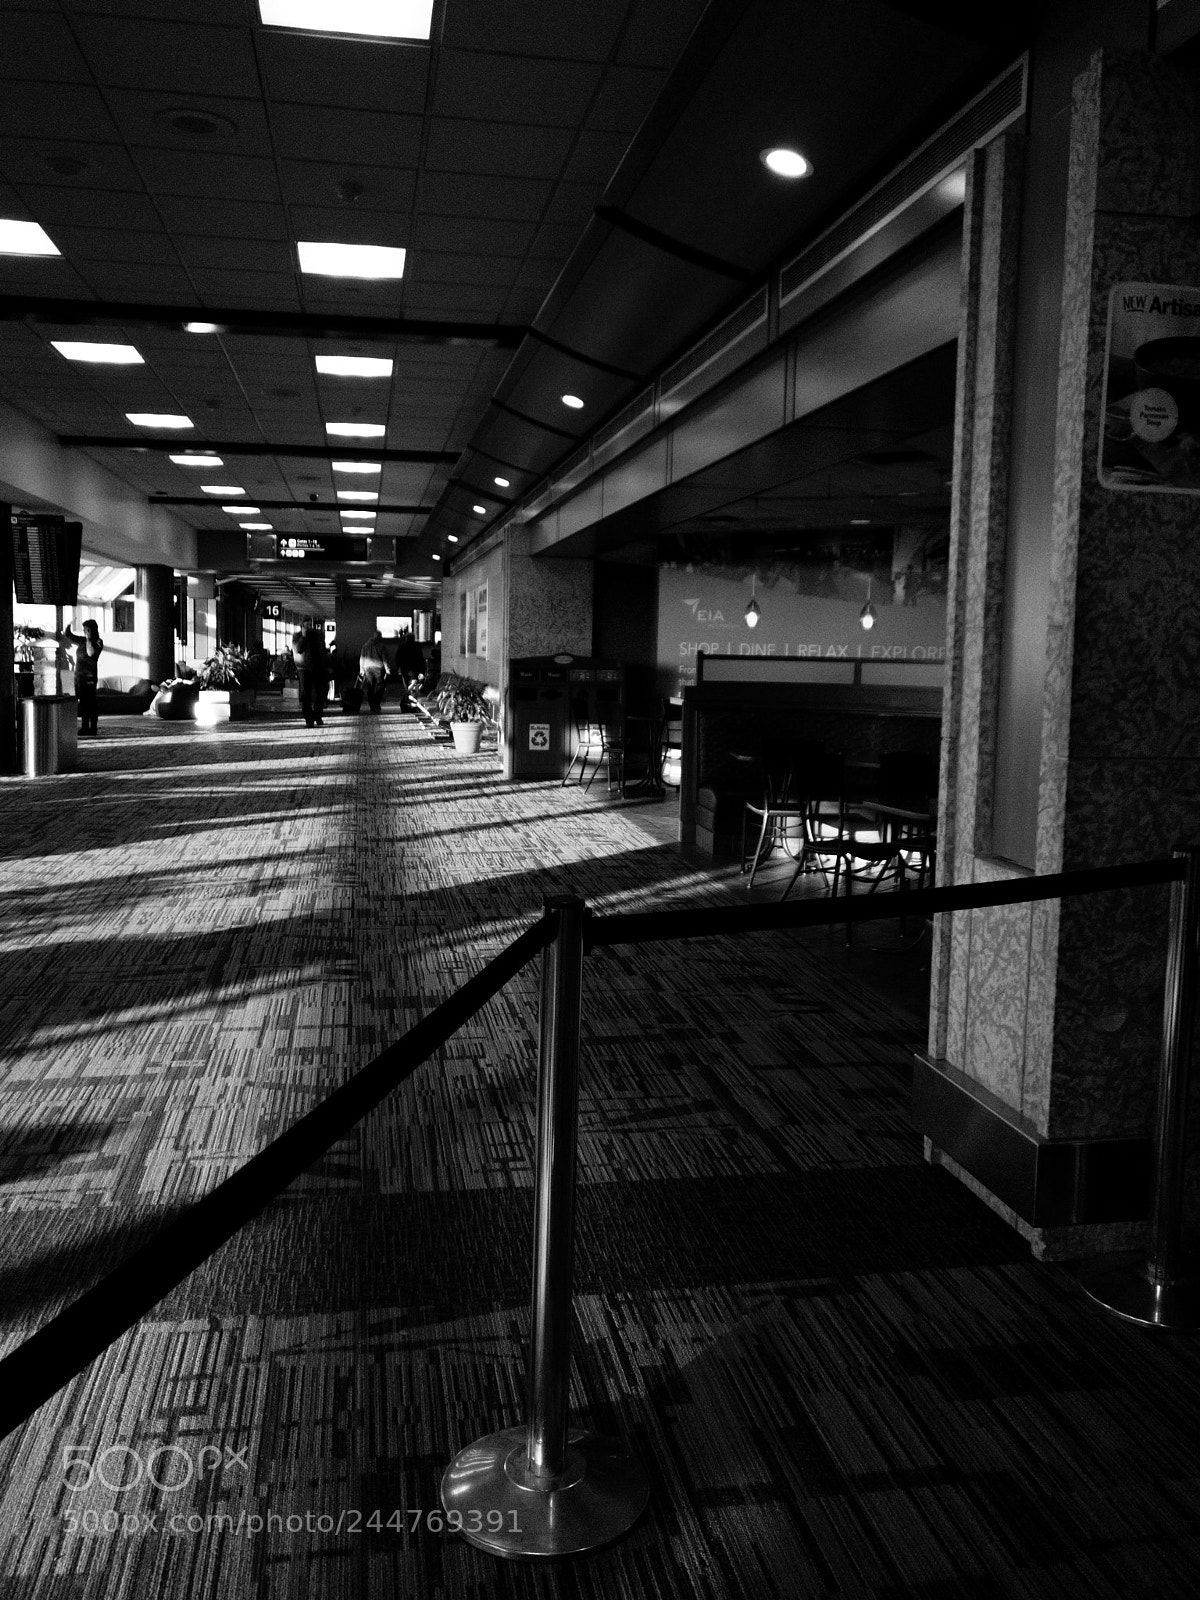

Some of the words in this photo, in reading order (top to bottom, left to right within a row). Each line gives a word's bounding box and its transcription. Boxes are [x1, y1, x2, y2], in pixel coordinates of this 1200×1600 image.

[1123, 295, 1147, 311] NEW
[266, 605, 280, 617] 16
[697, 609, 725, 622] EIA
[679, 641, 719, 657] SHOP
